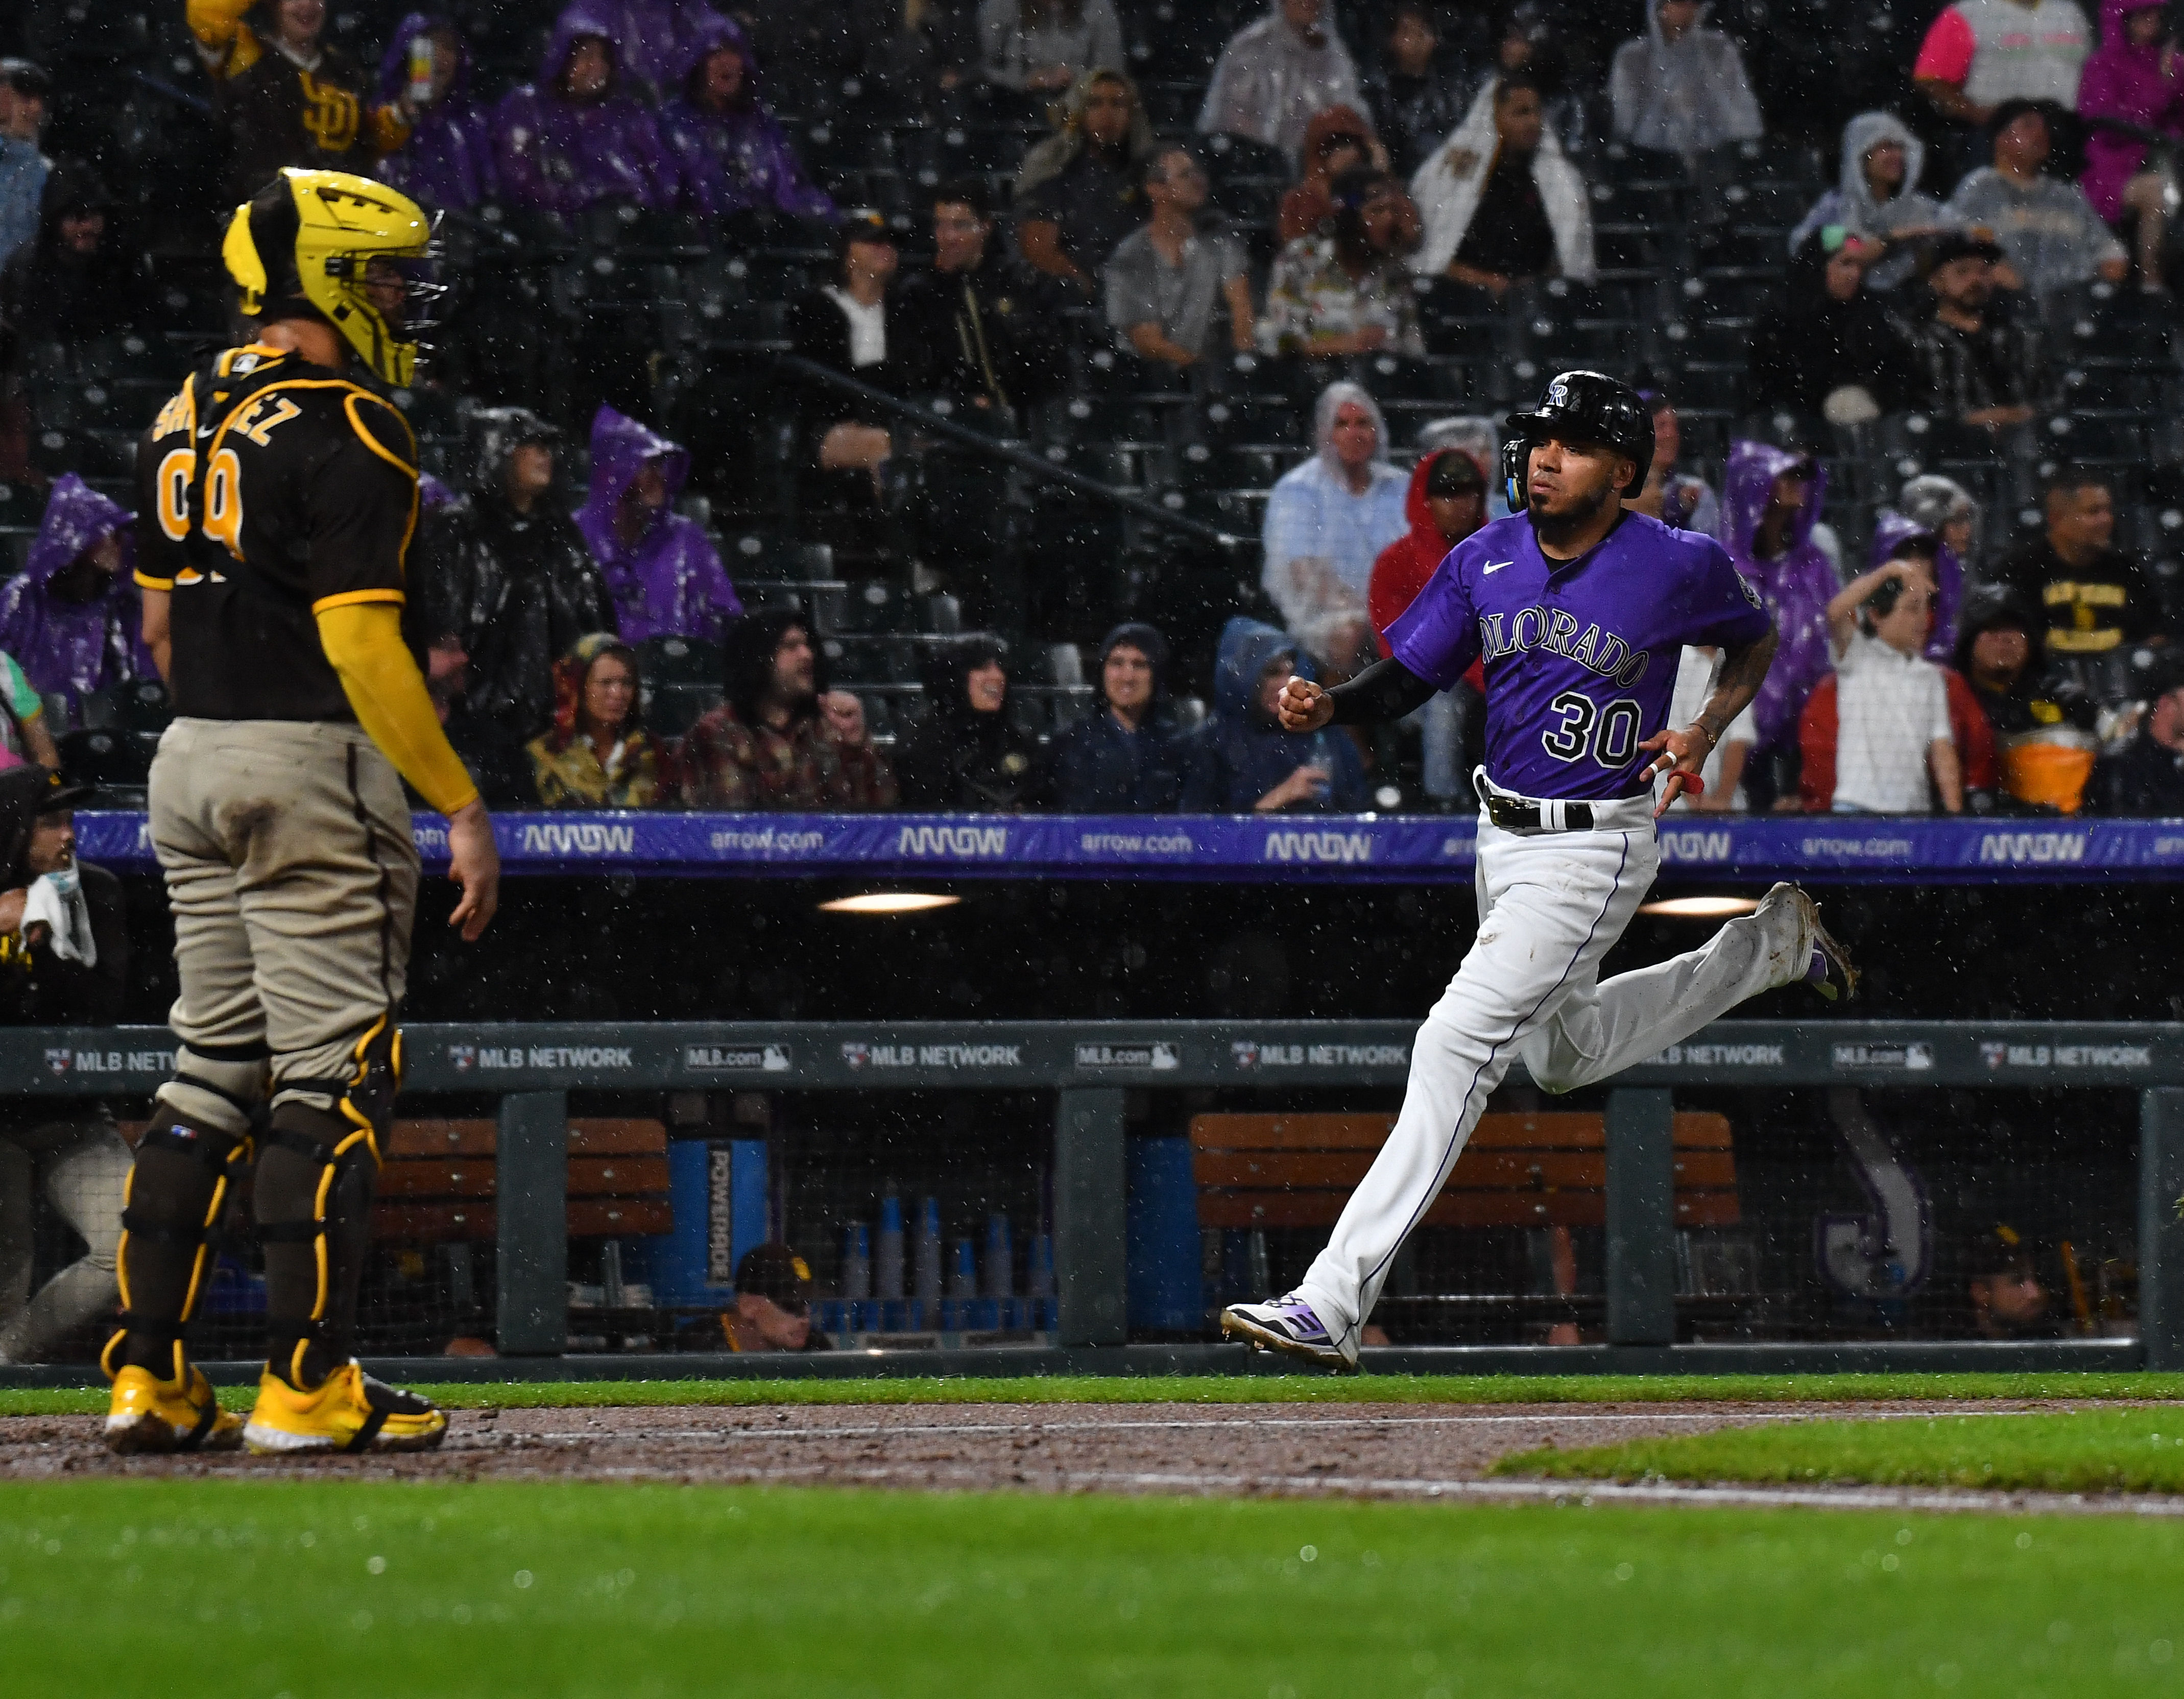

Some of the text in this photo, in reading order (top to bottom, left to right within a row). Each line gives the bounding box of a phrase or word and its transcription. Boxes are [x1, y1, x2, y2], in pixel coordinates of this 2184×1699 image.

[1479, 604, 1649, 689] OLORADO
[1541, 690, 1643, 769] 30
[524, 824, 634, 853] ARROW
[710, 832, 824, 851] arrow.com
[900, 827, 1006, 855] ARROW
[1081, 833, 1193, 852] arrow.com
[1265, 832, 1372, 862] ARROW
[1803, 838, 1911, 856] arrow.com
[1980, 833, 2085, 863] ARROW
[76, 1052, 123, 1071] MLB
[478, 1047, 633, 1068] MLB NETWORK
[871, 1046, 1022, 1066] MLB NETWORK
[1261, 1045, 1407, 1064] MLB NETWORK
[1686, 1045, 1782, 1065] NETWORK
[2007, 1046, 2151, 1066] MLB NETWORK
[710, 1150, 730, 1279] POWERADE
